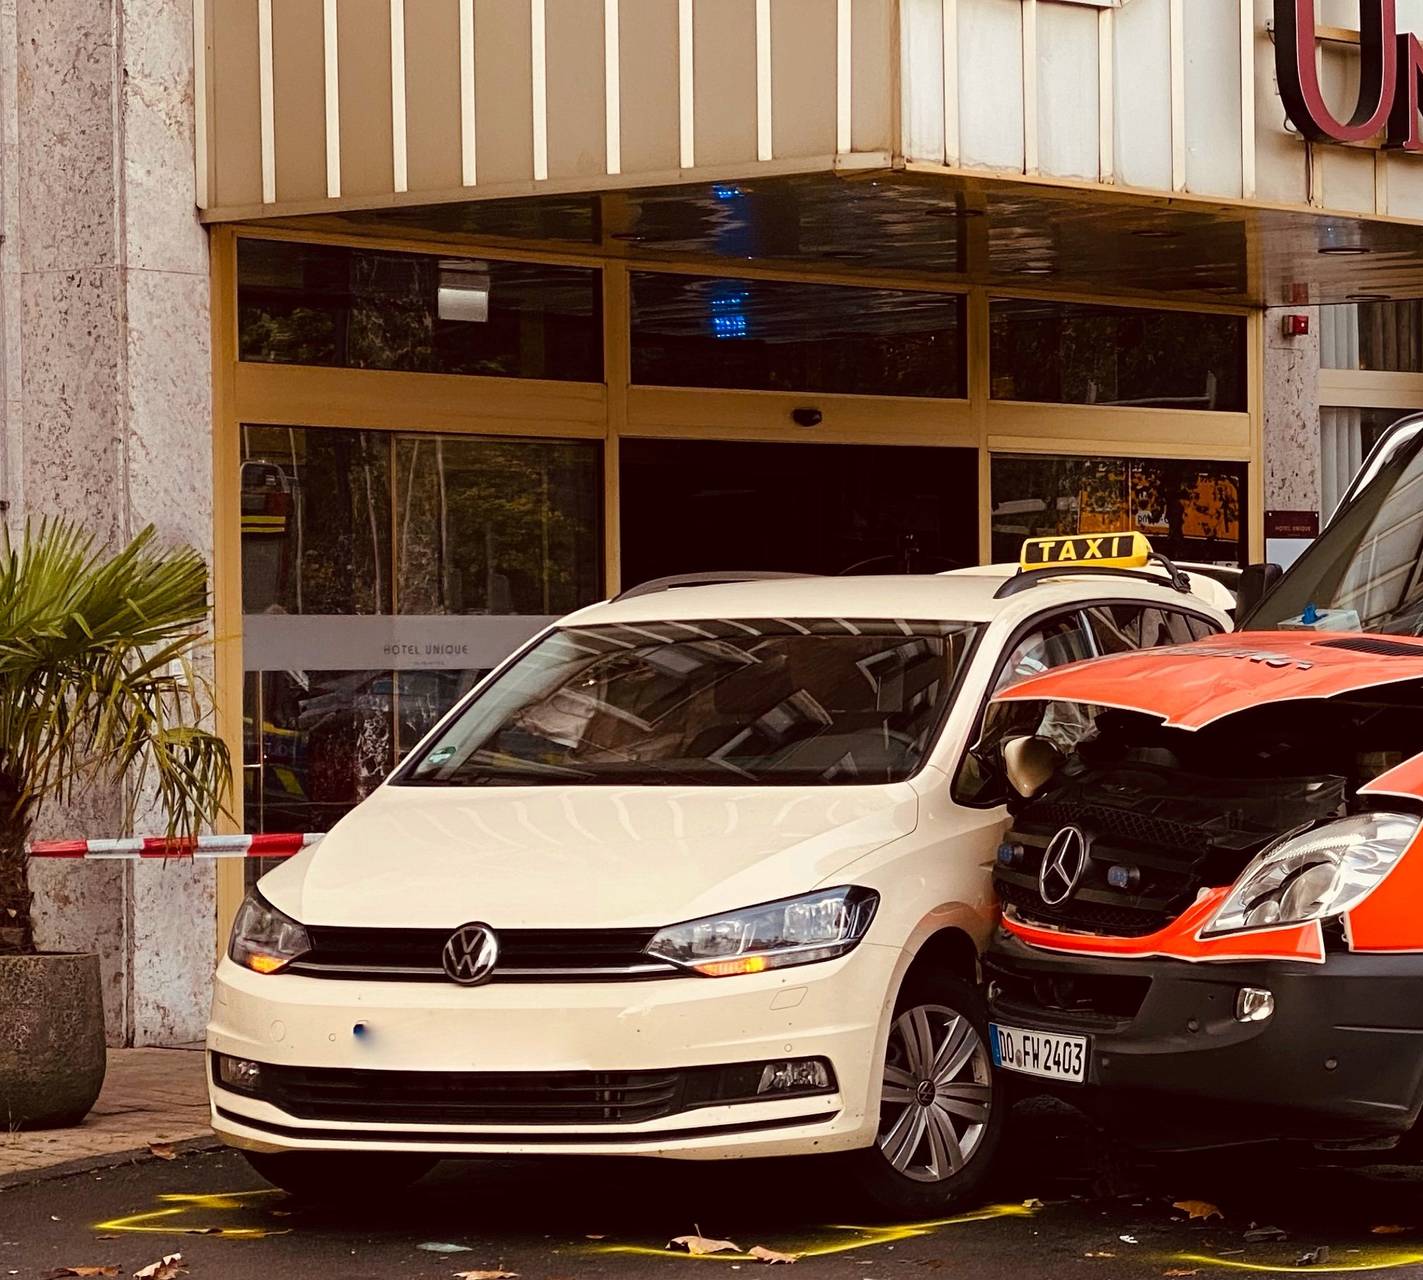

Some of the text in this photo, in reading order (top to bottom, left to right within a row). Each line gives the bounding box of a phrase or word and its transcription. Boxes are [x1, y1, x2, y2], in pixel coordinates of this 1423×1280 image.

[1038, 536, 1120, 562] TAXI
[383, 644, 469, 655] HOTEL UNIQUE
[998, 1030, 1014, 1063] DO
[1043, 1038, 1083, 1076] 2403
